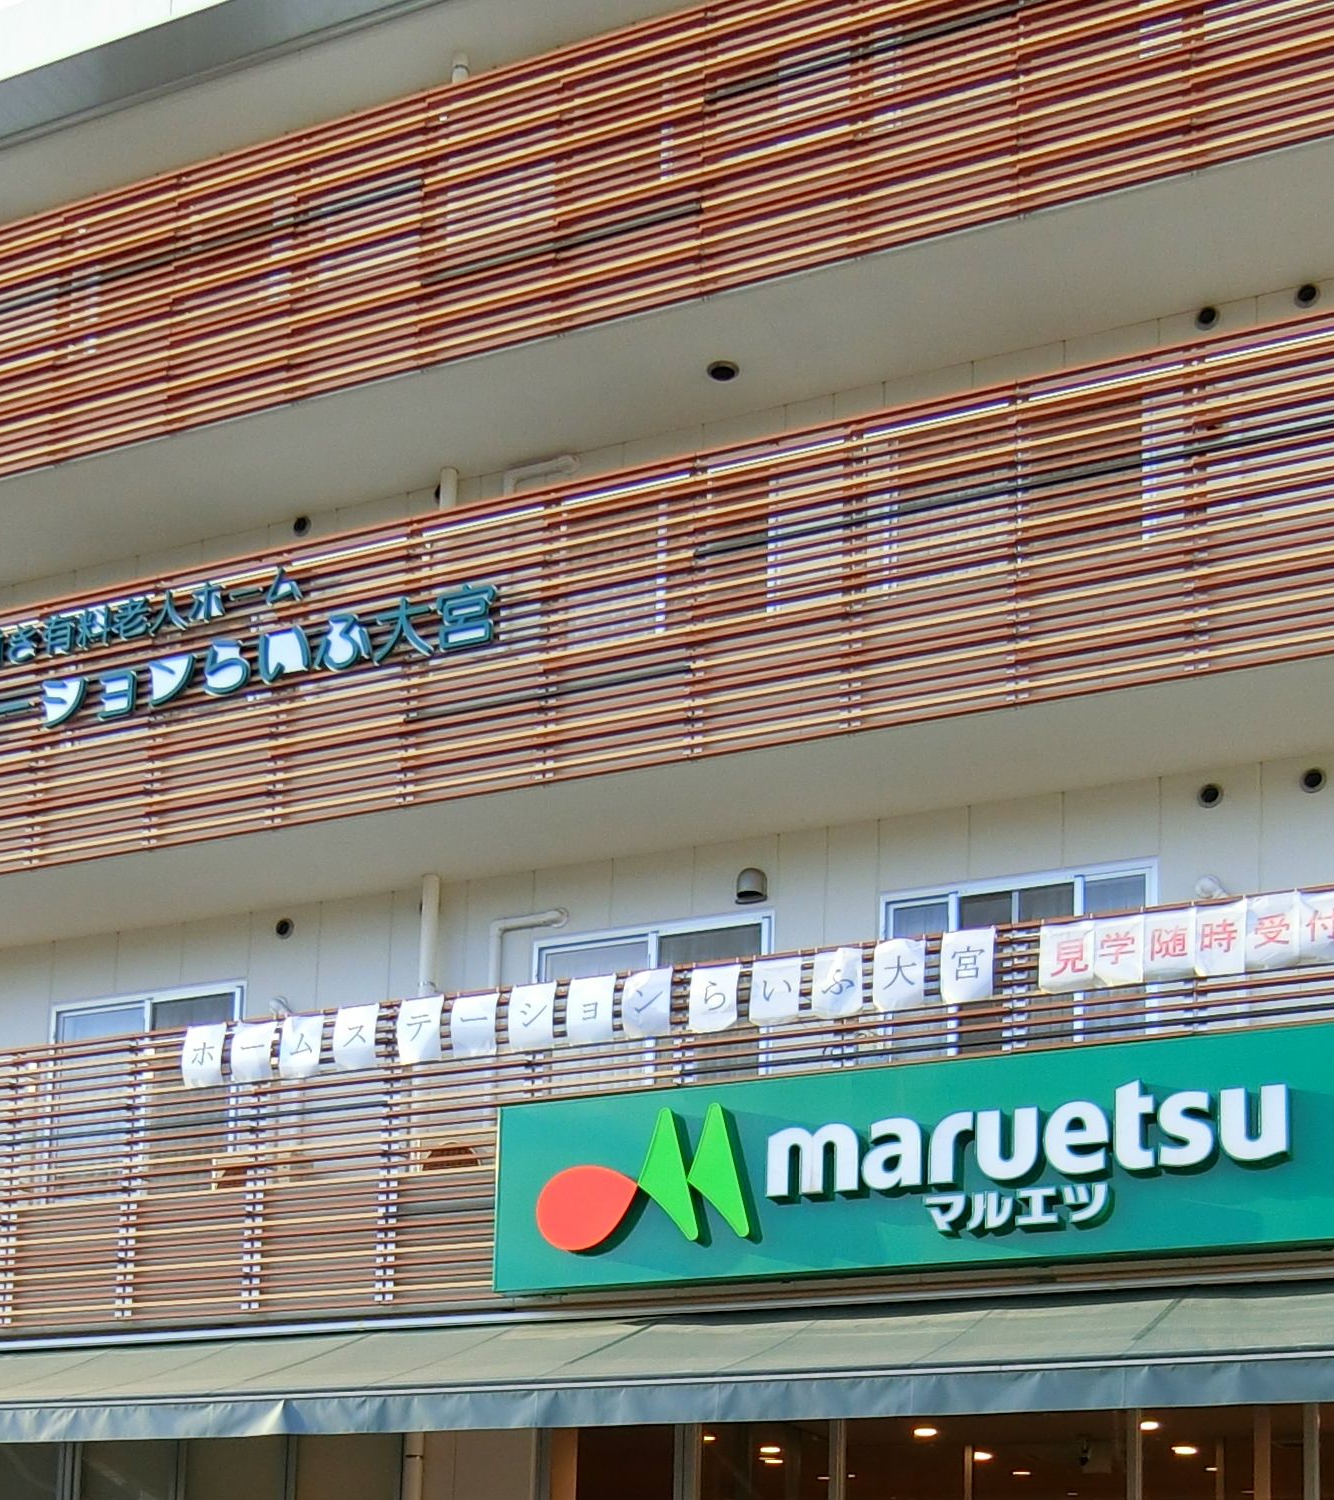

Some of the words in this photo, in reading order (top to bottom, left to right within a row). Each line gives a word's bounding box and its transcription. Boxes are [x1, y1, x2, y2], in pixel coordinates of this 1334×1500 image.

[190, 944, 982, 1067] ホームステーションらいふ大宮
[765, 1078, 1292, 1199] maruetsu
[923, 1181, 1110, 1234] マルエツ
